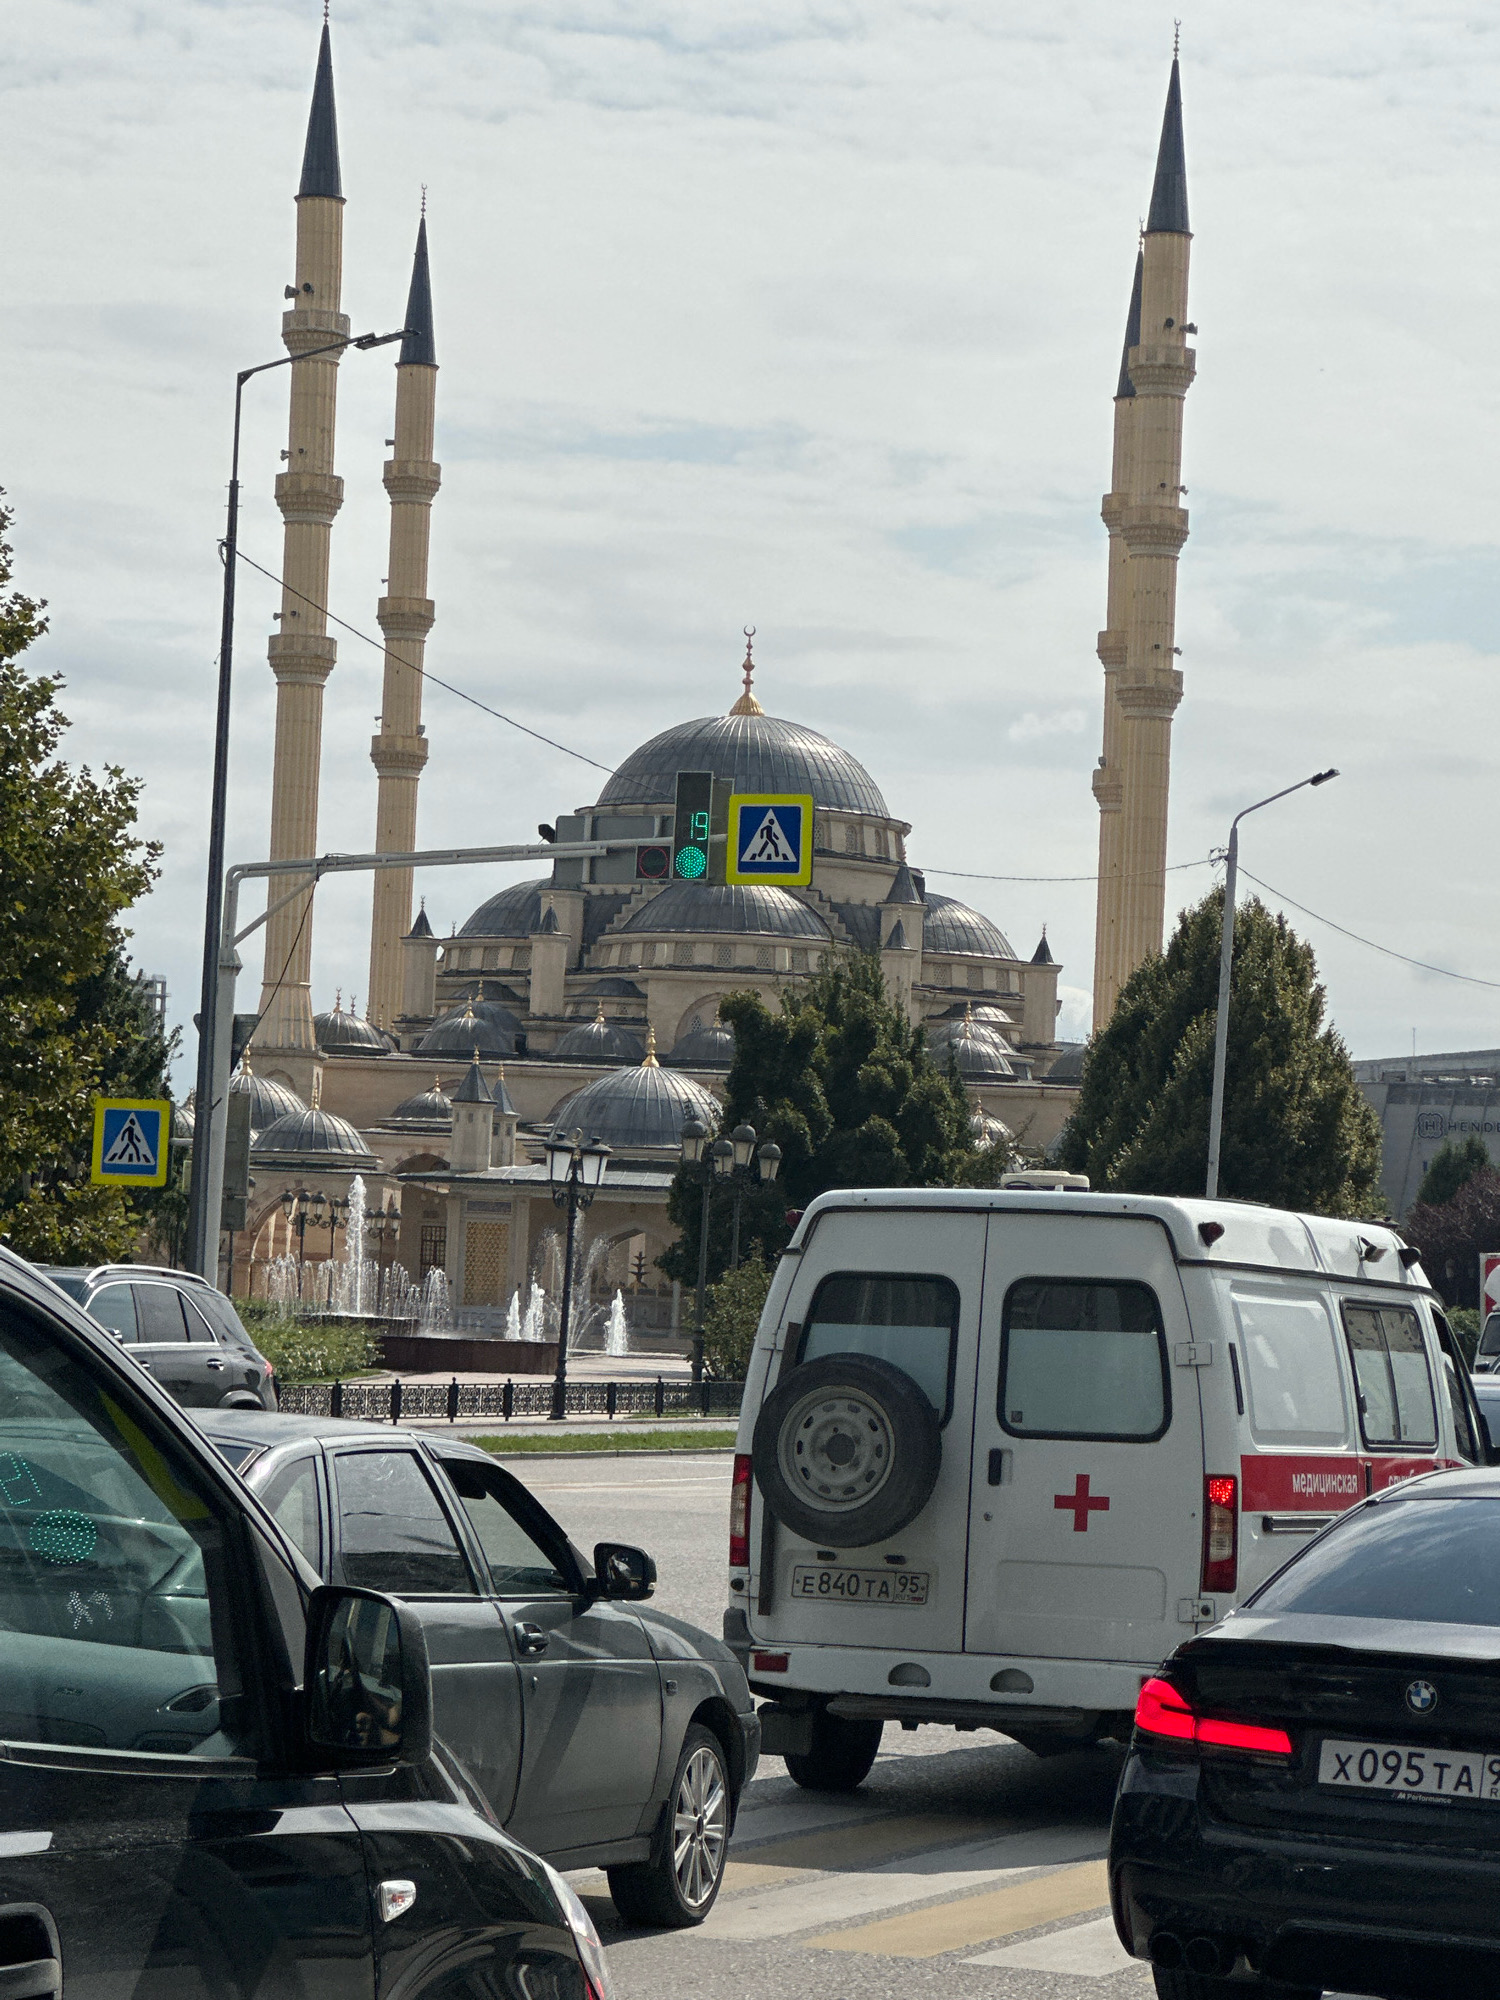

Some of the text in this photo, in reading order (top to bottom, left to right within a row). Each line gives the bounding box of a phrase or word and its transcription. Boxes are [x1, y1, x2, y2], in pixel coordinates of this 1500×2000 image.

[690, 812, 708, 841] 19
[1292, 1473, 1358, 1497] медицинская
[1332, 1748, 1474, 1793] Х095ТА
